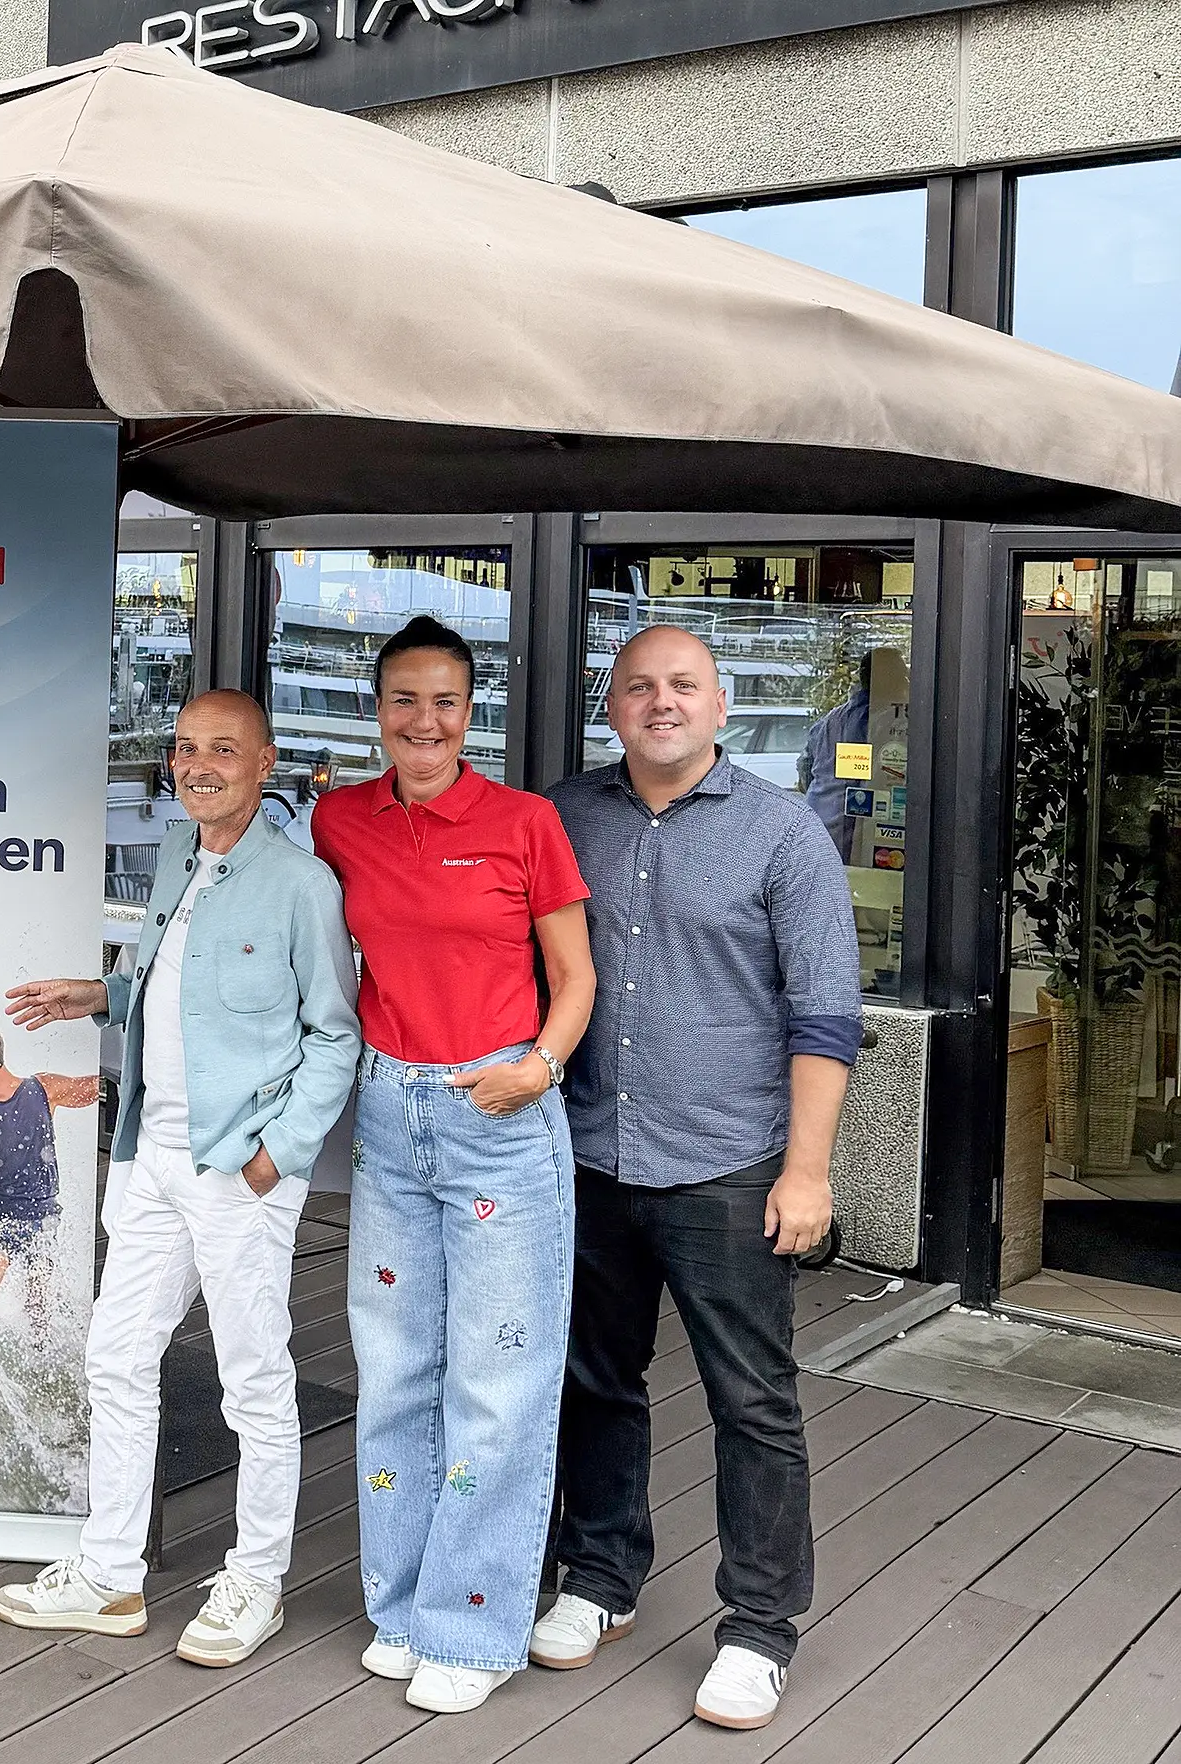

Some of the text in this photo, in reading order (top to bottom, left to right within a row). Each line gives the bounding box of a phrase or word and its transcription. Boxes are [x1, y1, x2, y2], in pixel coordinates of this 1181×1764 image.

[141, 0, 506, 67] RESTA
[853, 763, 870, 771] 2025
[880, 828, 902, 839] VISA
[441, 858, 474, 867] Austrian
